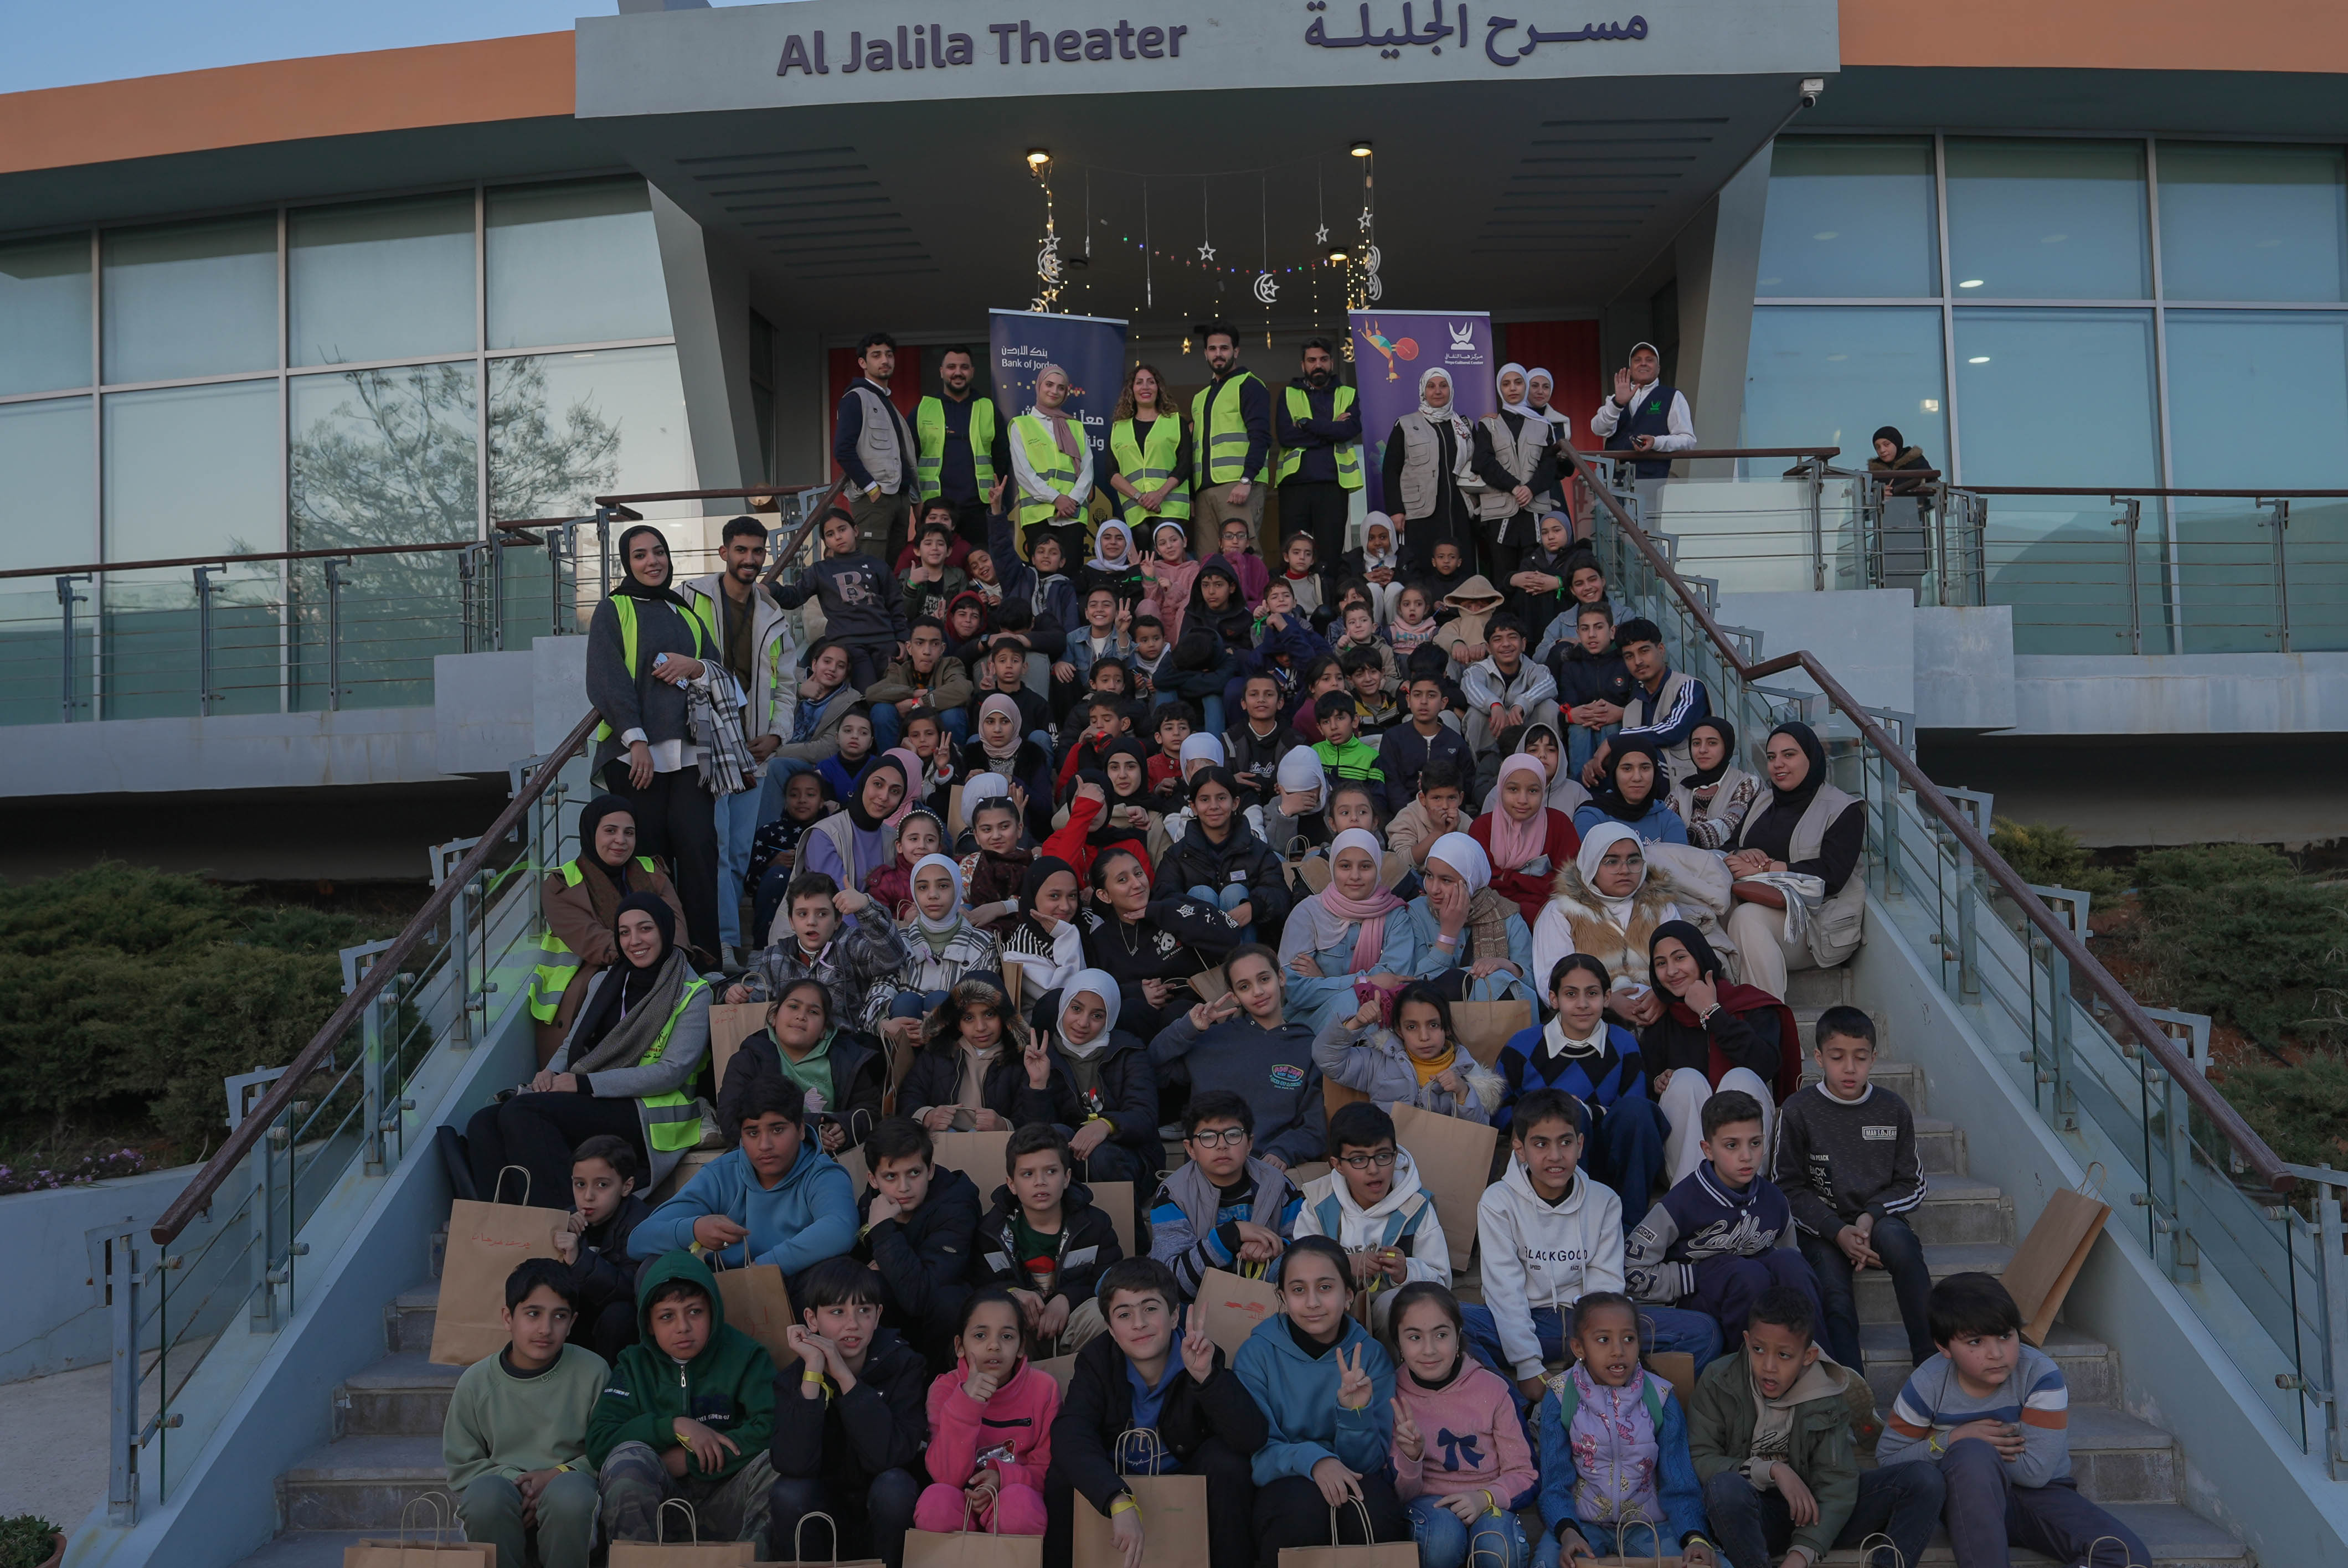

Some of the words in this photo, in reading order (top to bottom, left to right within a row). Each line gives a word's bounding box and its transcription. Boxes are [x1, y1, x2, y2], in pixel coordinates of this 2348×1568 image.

[1305, 0, 1468, 59] الجليلة
[1485, 15, 1648, 66] مسرح
[777, 30, 828, 76] Al
[842, 24, 972, 73] Jalila
[989, 20, 1187, 64] Theater
[1002, 359, 1022, 367] Bank
[1024, 359, 1032, 368] of
[1029, 347, 1048, 359] بنك
[1810, 1165, 1827, 1177] BACK
